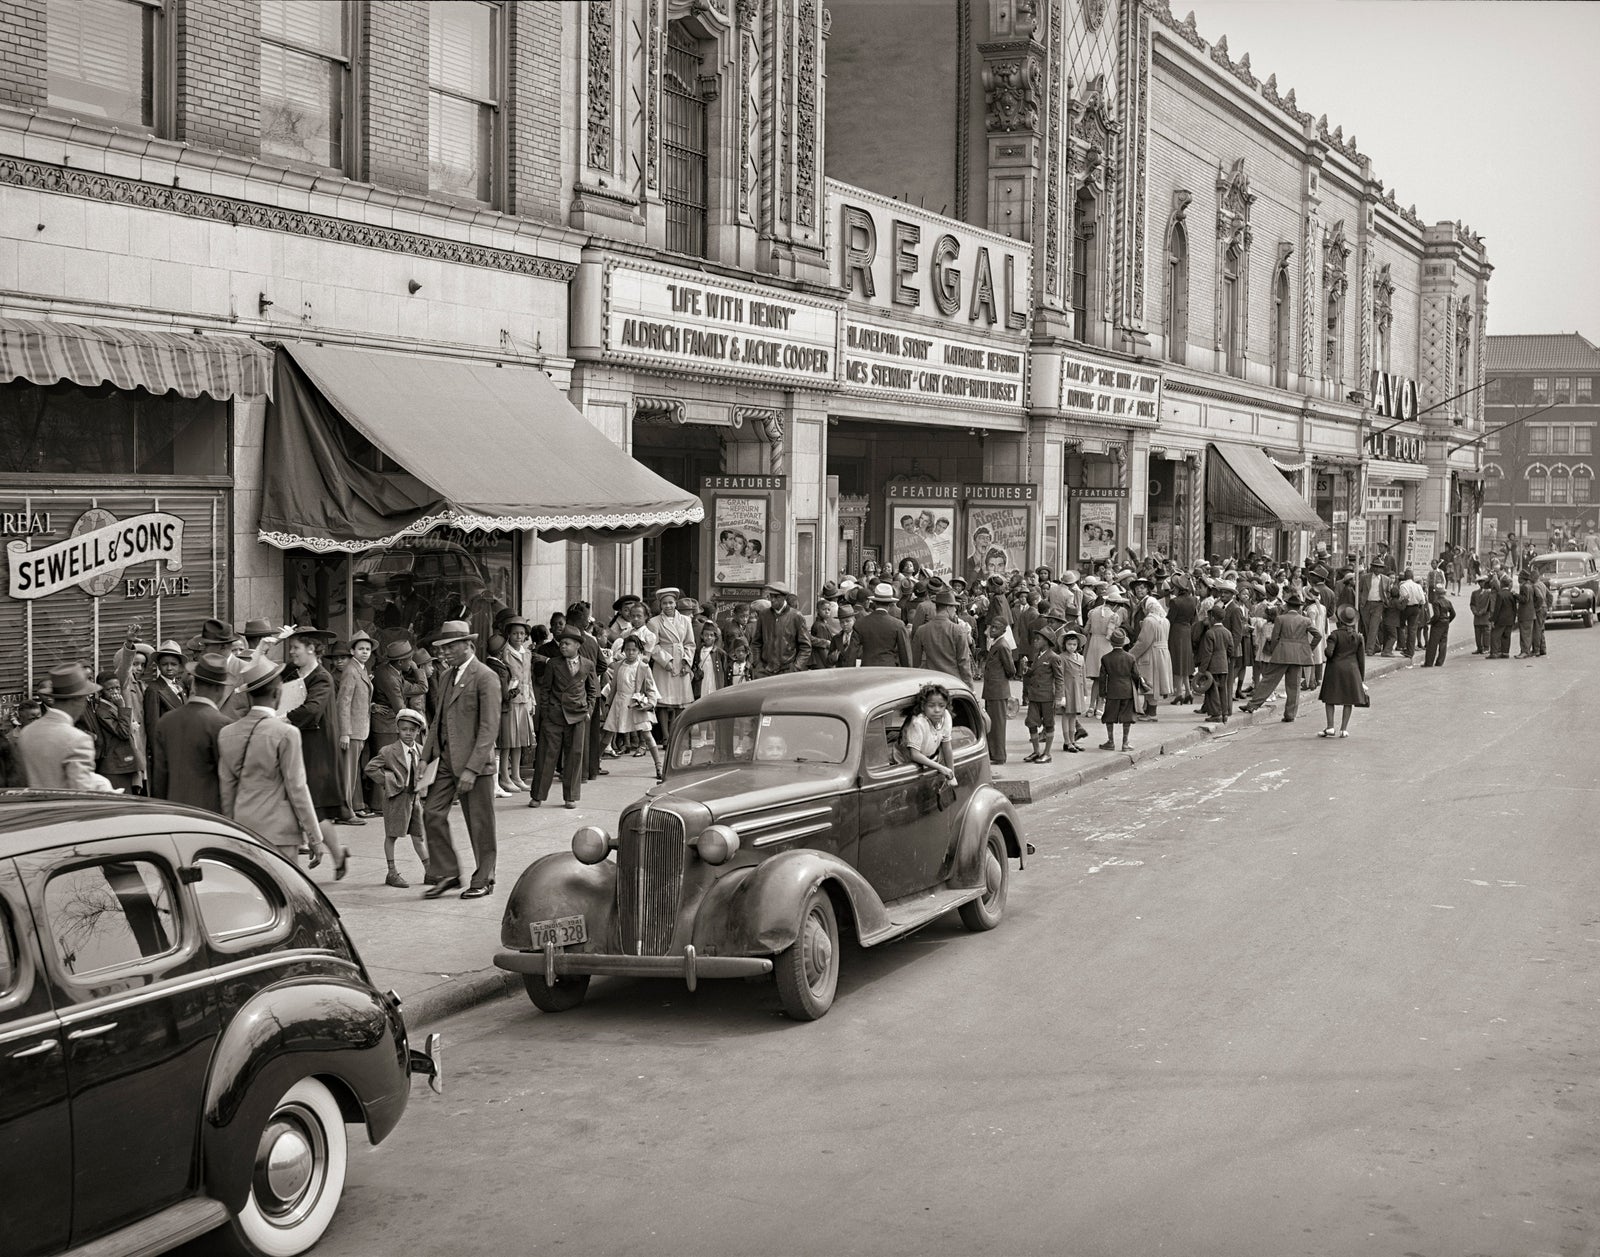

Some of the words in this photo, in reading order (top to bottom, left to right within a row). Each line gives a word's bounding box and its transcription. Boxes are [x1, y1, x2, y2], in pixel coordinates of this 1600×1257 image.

[841, 204, 1026, 329] REGAL
[667, 284, 701, 315] "LIFE
[706, 292, 743, 323] WITH
[749, 300, 796, 330] HENRY"
[621, 319, 679, 353] ALDRICH
[683, 328, 728, 359] FAMILY
[730, 336, 739, 361] &
[742, 339, 781, 368] JACKIE
[783, 344, 829, 373] COOPER
[902, 336, 933, 360] STORY"
[944, 344, 984, 369] KATHARINE
[987, 352, 1020, 373] HEPBURN
[871, 364, 913, 389] STEWART
[919, 371, 941, 393] CARY
[990, 382, 1018, 401] HUSSEY
[1067, 389, 1094, 409] NOTHING
[1097, 394, 1111, 411] CUT
[705, 477, 712, 488] 2
[716, 478, 781, 488] FEATURES
[890, 485, 897, 497] 2
[902, 486, 958, 498] FEATURE
[965, 487, 1020, 499] PICTURES
[1026, 488, 1032, 499] 2
[1071, 489, 1076, 497] 2
[1079, 489, 1126, 497] FEATURES
[3, 512, 56, 534] REAL
[975, 509, 1014, 528] ALDRICH
[991, 516, 1024, 531] FAMILY
[18, 538, 105, 590] SEWELL
[123, 522, 176, 558] SONS
[126, 576, 191, 599] ESTATE
[561, 925, 584, 943] 328
